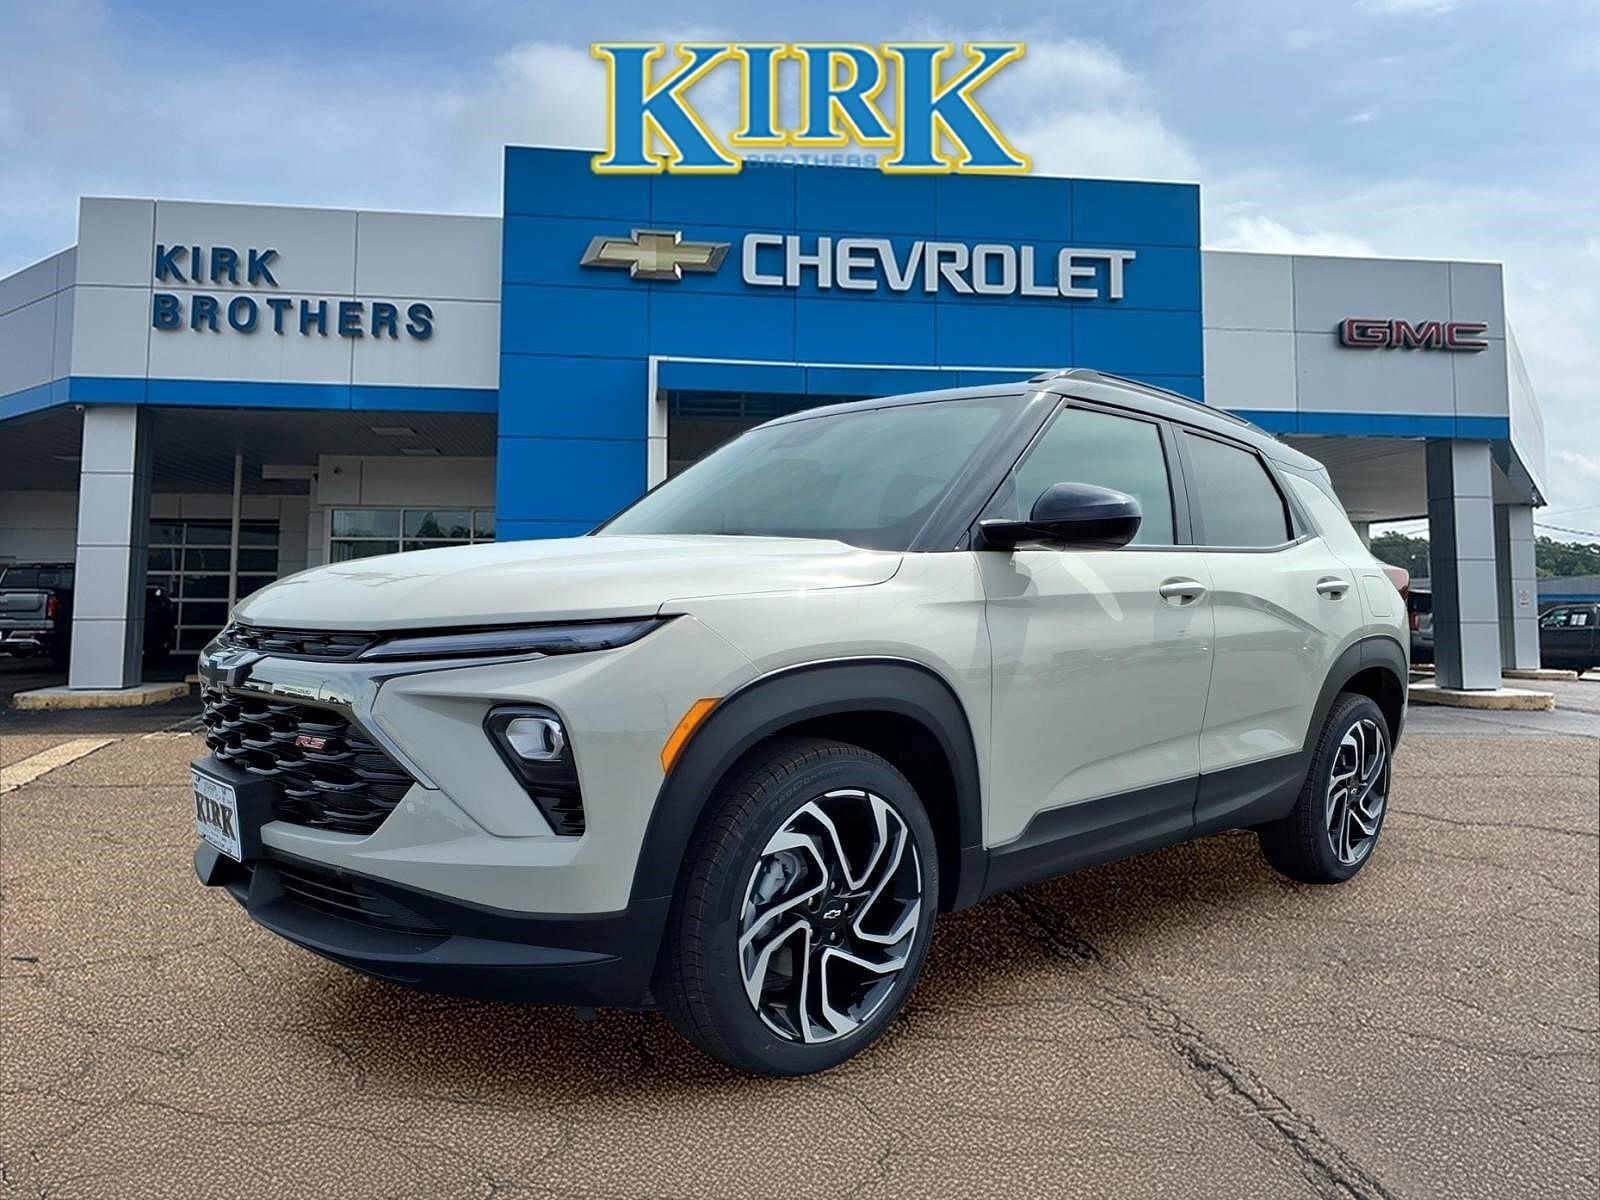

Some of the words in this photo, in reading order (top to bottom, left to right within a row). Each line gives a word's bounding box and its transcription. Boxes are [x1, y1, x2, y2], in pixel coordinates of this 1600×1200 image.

[155, 244, 279, 287] KIRK
[742, 233, 1136, 300] CHEVROLET
[152, 293, 434, 340] BROTHERS
[1340, 318, 1488, 352] GMC
[295, 735, 326, 749] RS
[194, 790, 237, 842] KIRK
